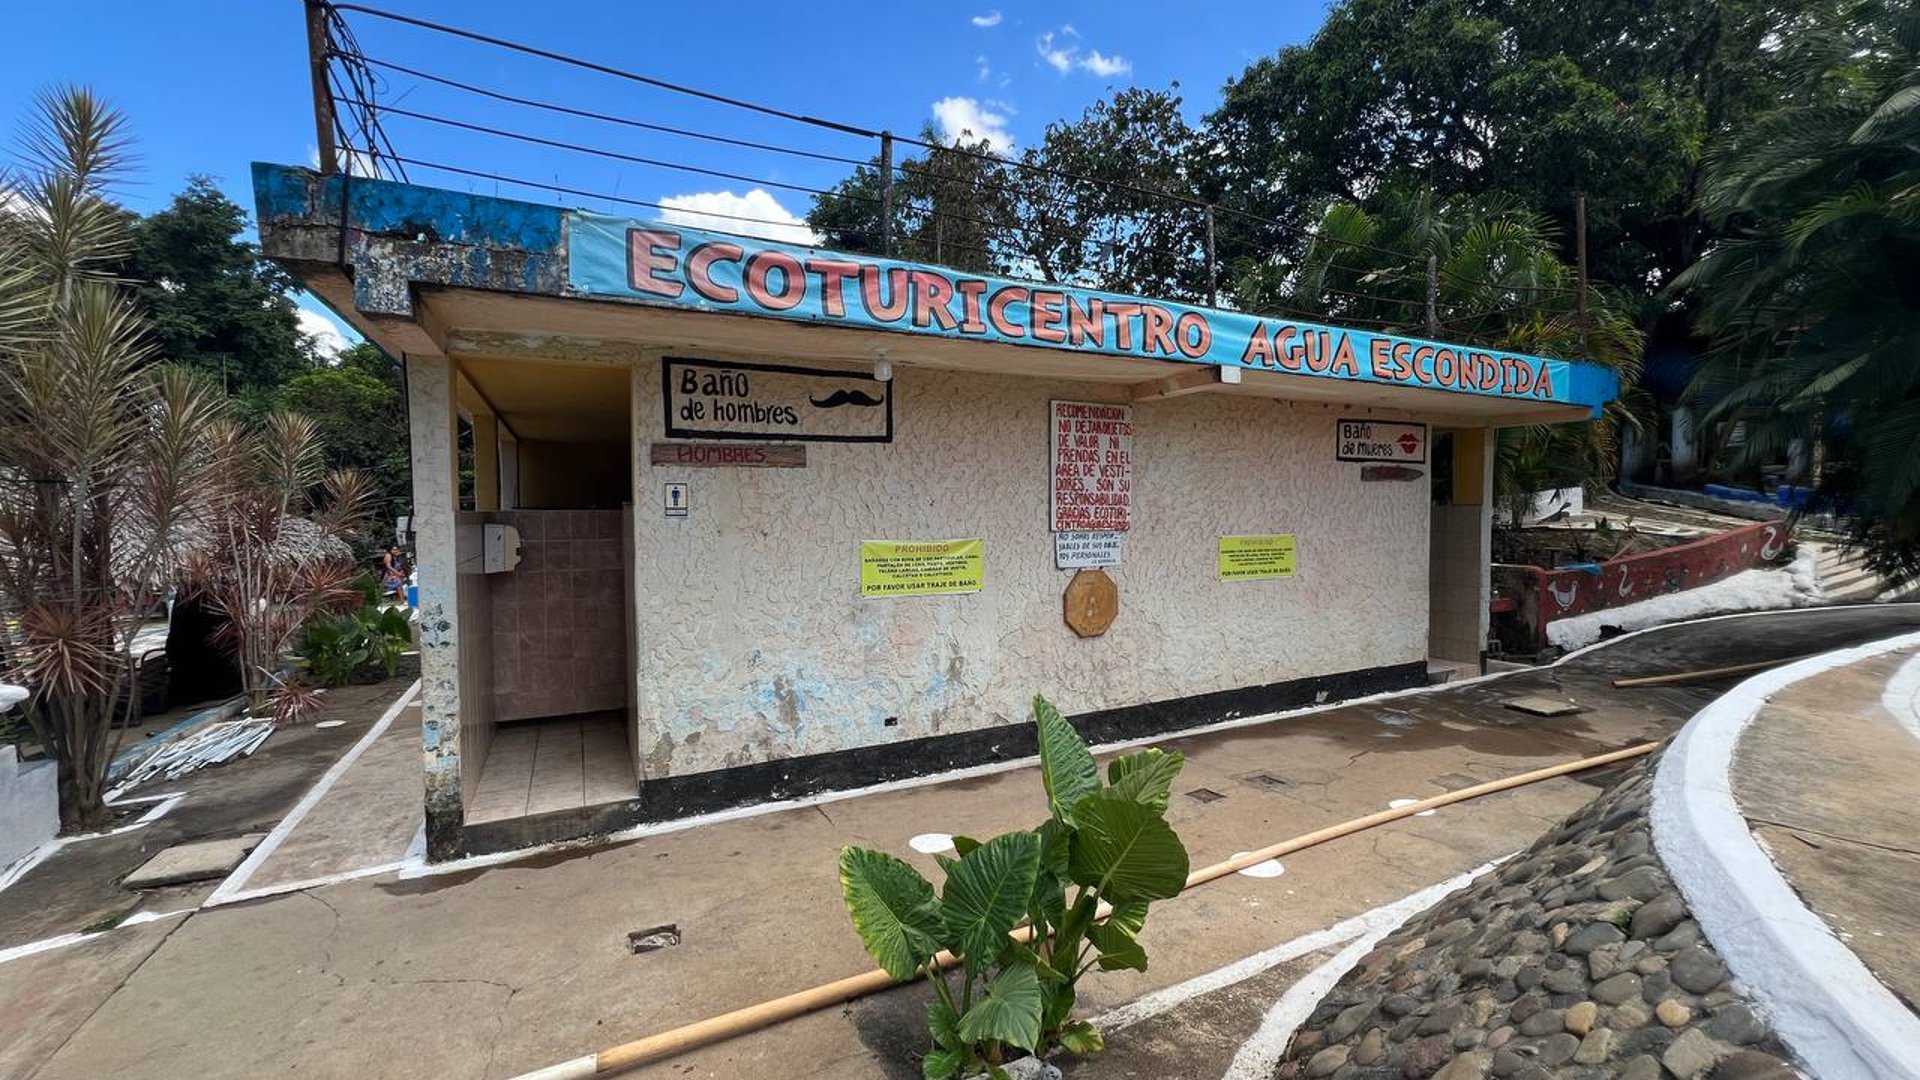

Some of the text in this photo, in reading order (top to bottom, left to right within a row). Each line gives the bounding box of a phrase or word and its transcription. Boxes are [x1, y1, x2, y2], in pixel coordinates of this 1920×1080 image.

[626, 227, 1554, 399] ECOTURICENTRO AGUA ESCONDIDA
[681, 369, 749, 397] Baño
[681, 399, 799, 425] de hombres
[1059, 420, 1071, 432] NO
[1058, 434, 1069, 448] DE
[1074, 435, 1100, 449] VALOR
[1342, 441, 1355, 455] de
[677, 446, 767, 463] HOMBRES
[1057, 448, 1100, 463] PRENDAS
[1120, 451, 1131, 465] EL
[1056, 463, 1131, 478] AREA DE VESTI-
[1096, 478, 1114, 492] SON
[1119, 478, 1130, 493] SU
[1056, 506, 1091, 520] GRACIAS
[895, 544, 949, 553] PROHIBIDO
